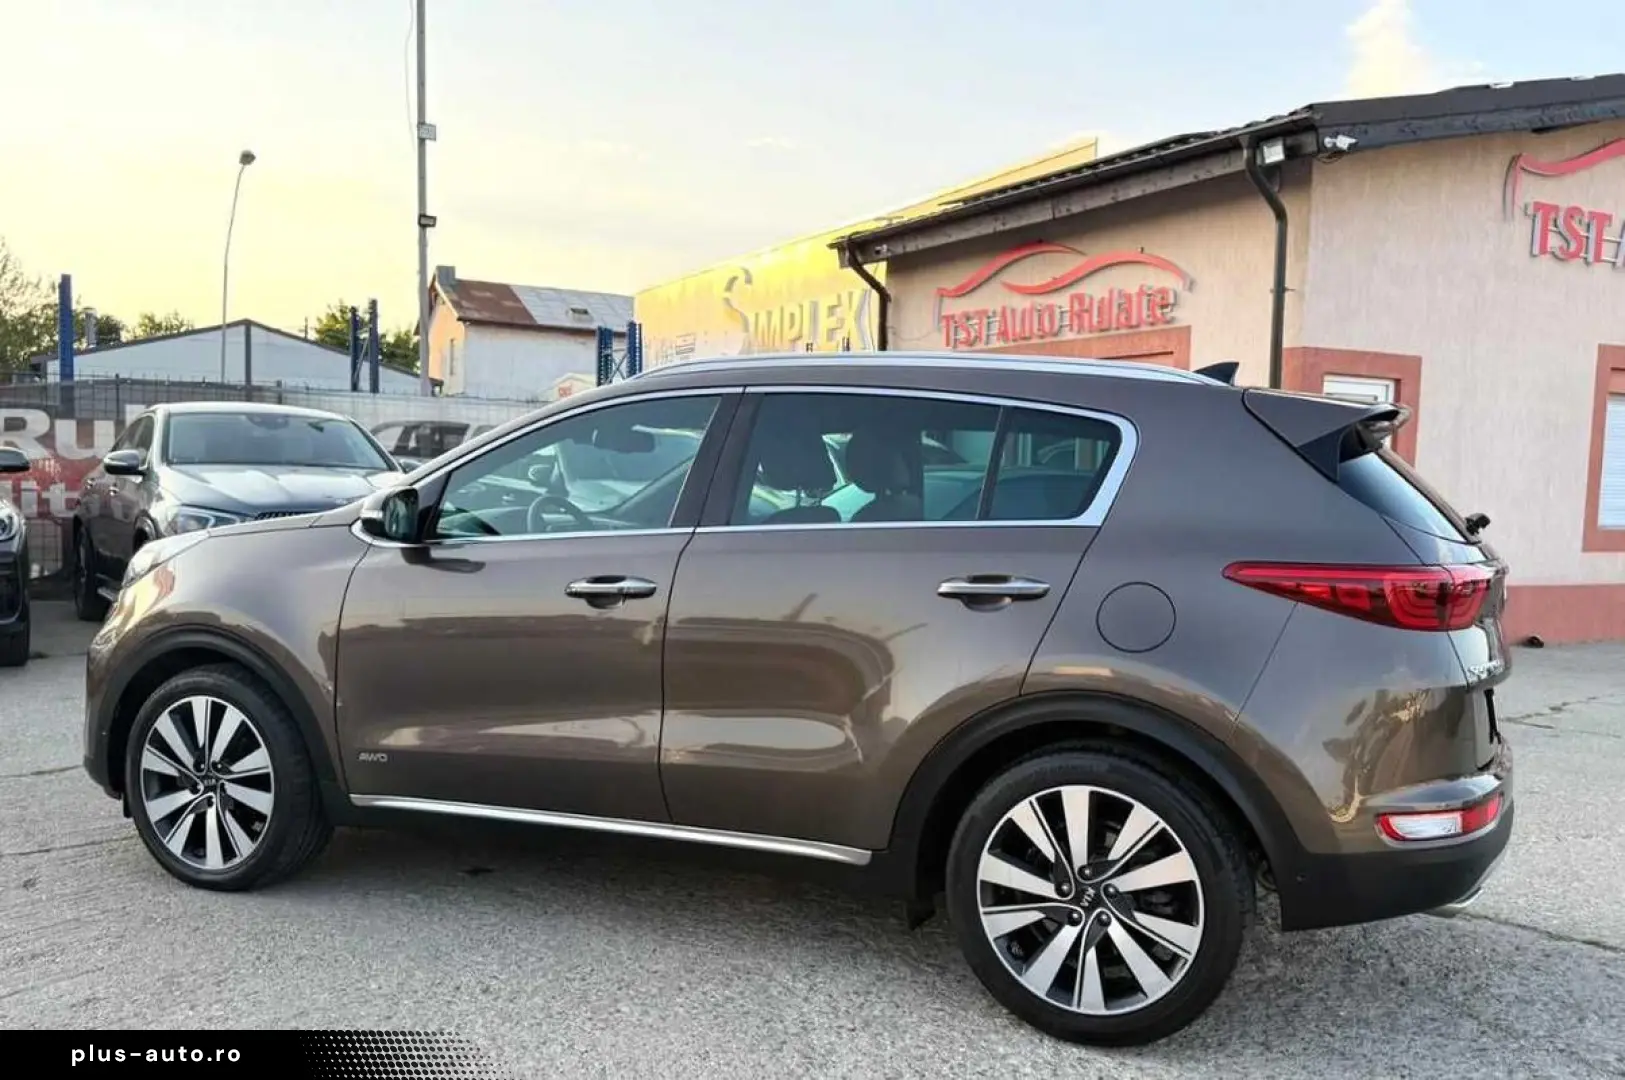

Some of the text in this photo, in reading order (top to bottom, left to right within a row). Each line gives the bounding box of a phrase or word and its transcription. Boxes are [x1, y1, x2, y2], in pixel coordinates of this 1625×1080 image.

[1531, 201, 1614, 264] TST
[941, 284, 1175, 348] TST Auto Rulate
